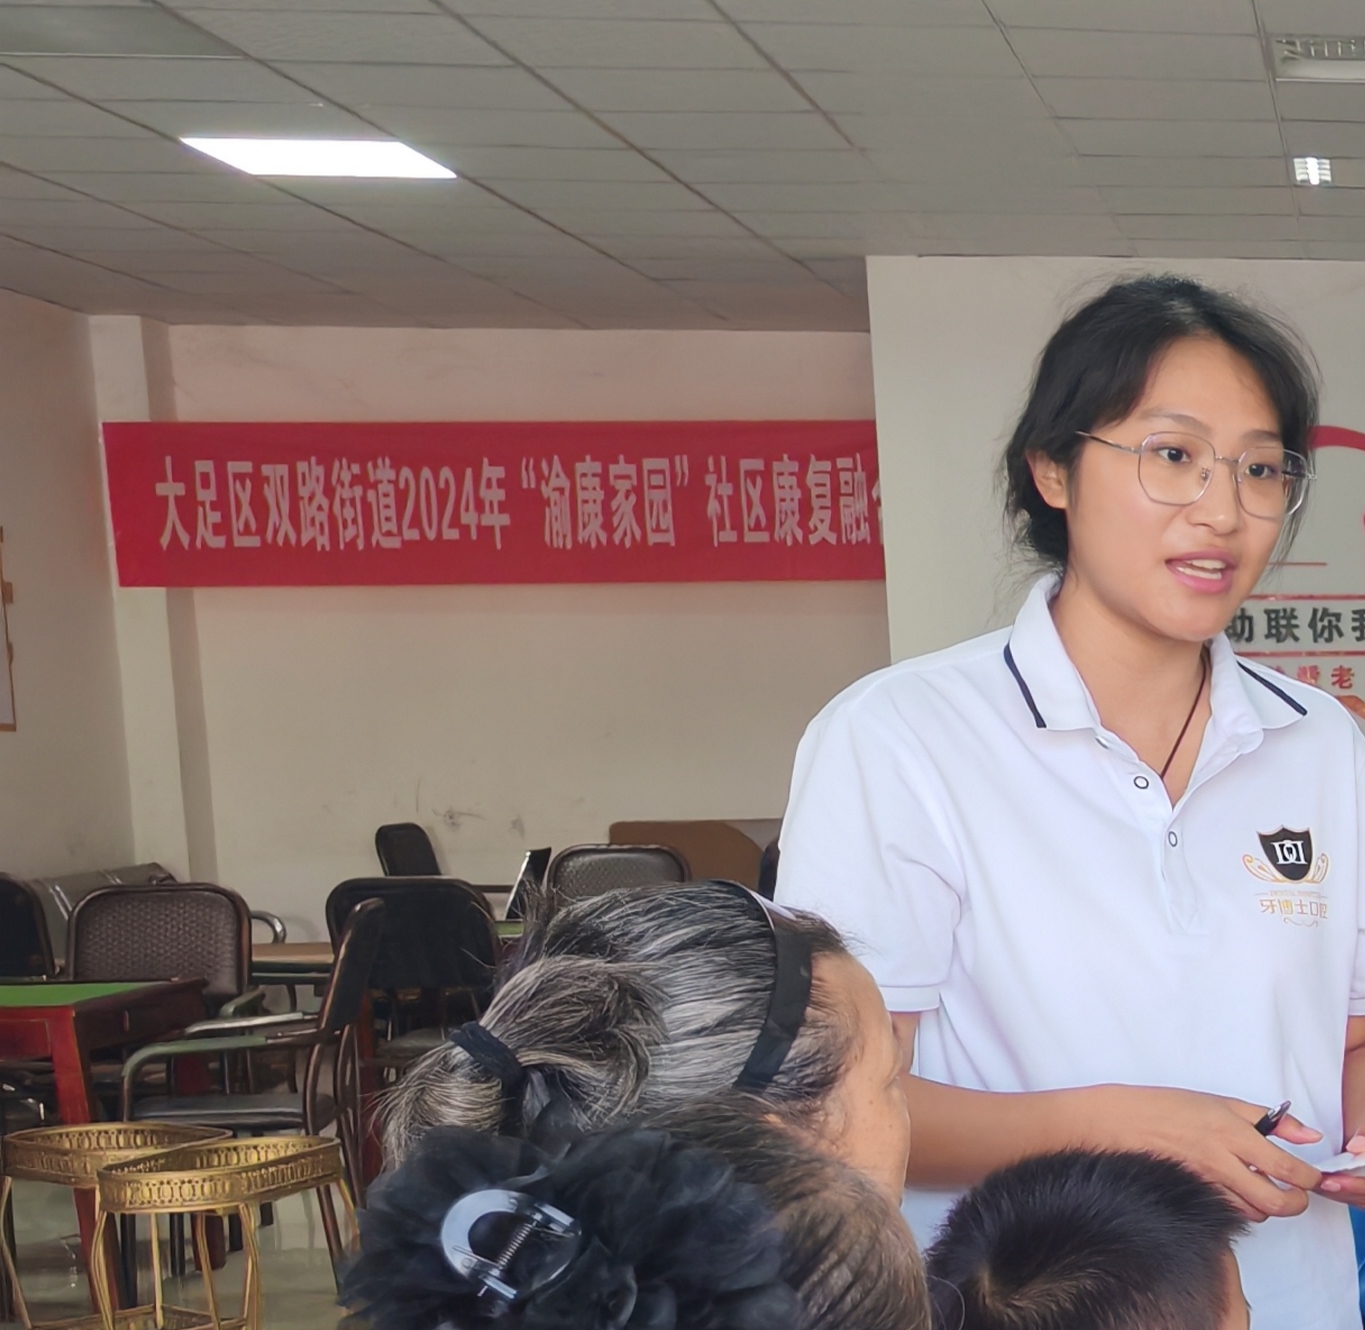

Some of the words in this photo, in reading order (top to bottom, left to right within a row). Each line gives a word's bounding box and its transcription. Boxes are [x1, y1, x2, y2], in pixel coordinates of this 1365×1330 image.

[154, 453, 886, 553] 大足区双路街道2024年“渝康家园”社区康复融
